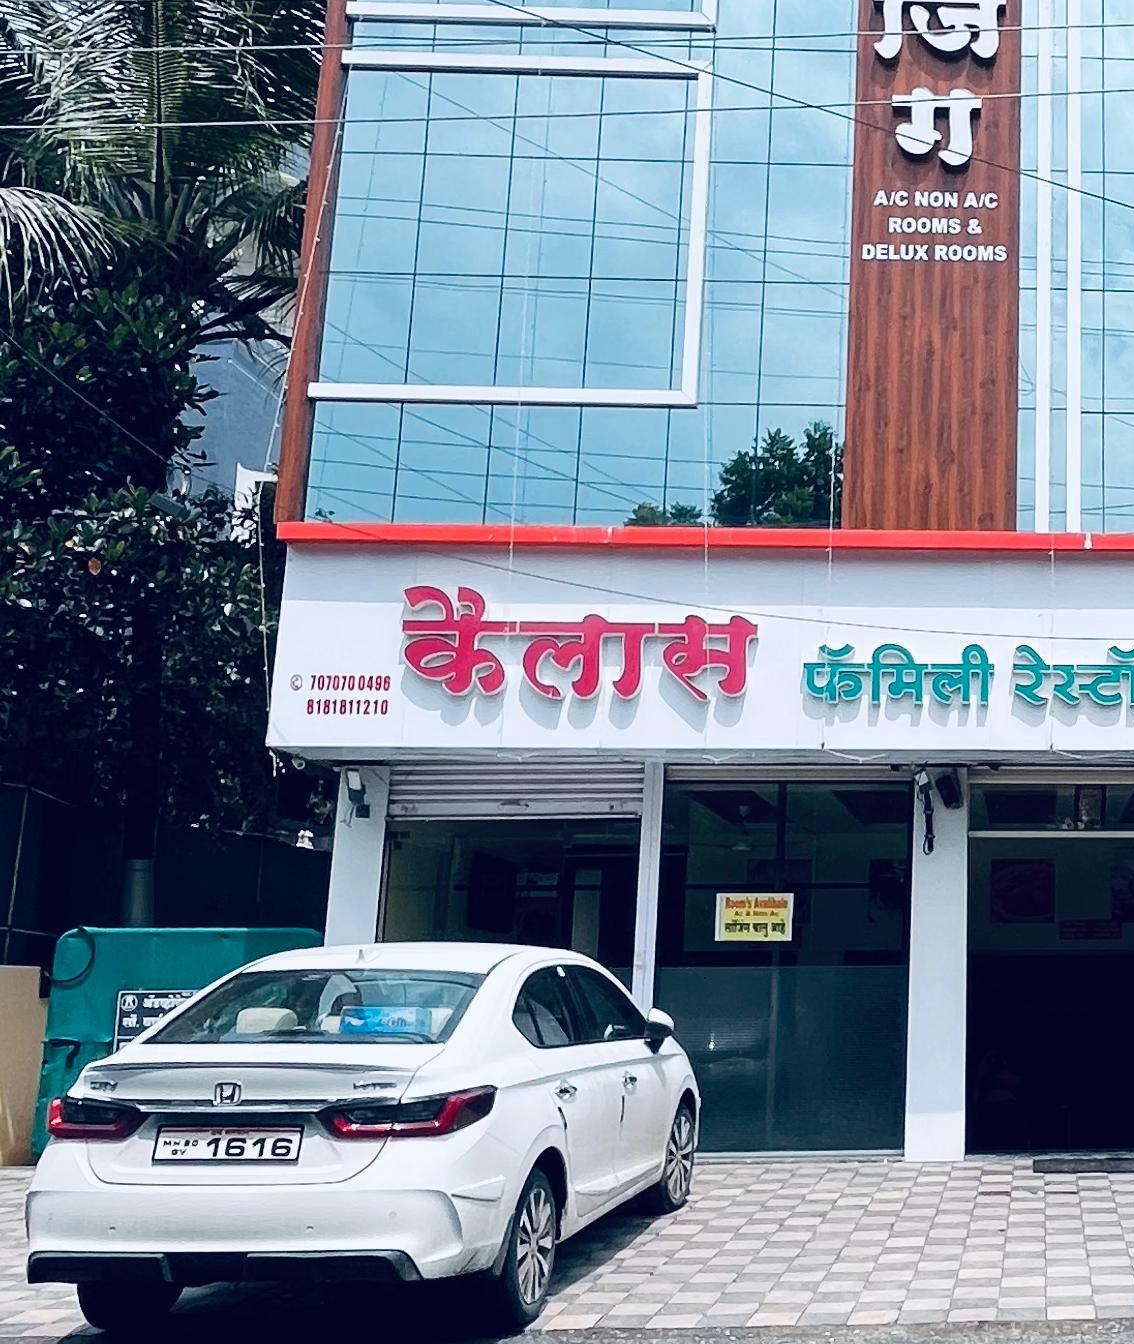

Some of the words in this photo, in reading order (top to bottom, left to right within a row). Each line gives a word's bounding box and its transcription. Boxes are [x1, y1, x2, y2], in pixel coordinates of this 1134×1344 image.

[873, 190, 909, 207] A/C
[914, 191, 959, 208] NON
[963, 192, 999, 209] A/C
[888, 217, 961, 234] ROOMS
[966, 218, 983, 235] &
[861, 243, 929, 261] DELUX
[933, 244, 1008, 261] ROOMS
[402, 585, 760, 702] कैलास
[802, 643, 995, 706] फॅमिली
[307, 699, 388, 715] 8181811210
[206, 1137, 293, 1158] 1616
